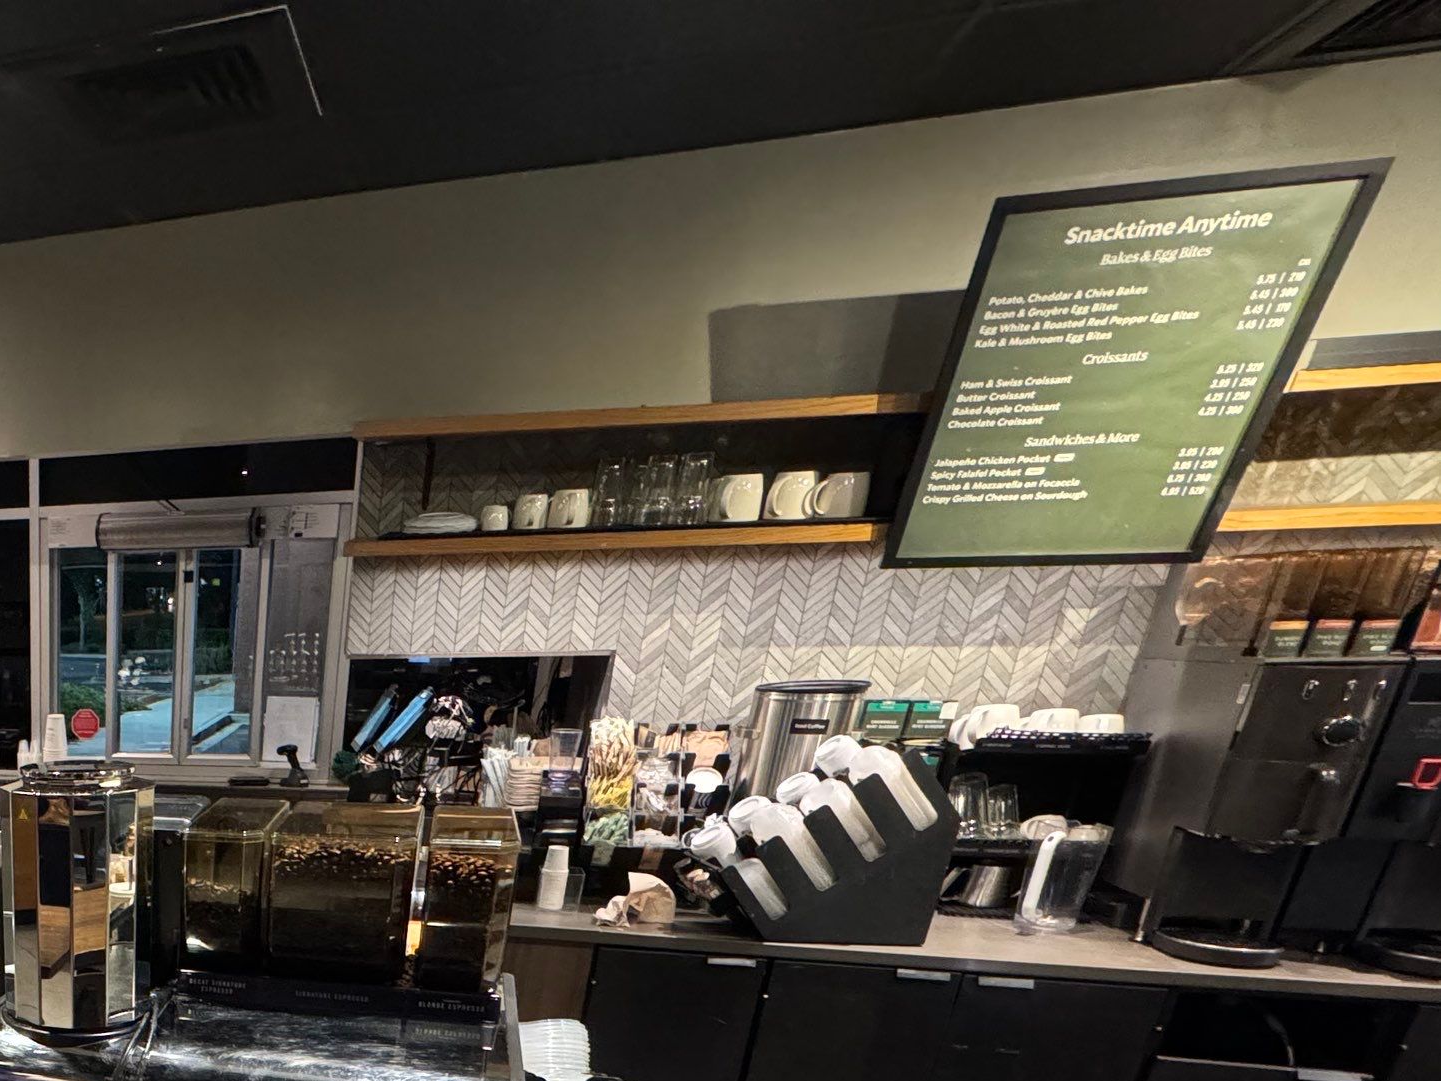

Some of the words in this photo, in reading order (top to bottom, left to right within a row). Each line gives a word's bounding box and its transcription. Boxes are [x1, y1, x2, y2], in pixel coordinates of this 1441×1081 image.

[1063, 218, 1176, 245] Snacktime
[1175, 210, 1272, 235] Anytime
[1099, 251, 1139, 265] Bakes
[1139, 250, 1151, 263] &
[1151, 248, 1178, 263] Egg
[1177, 245, 1212, 259] Bites
[988, 295, 1025, 306] Potato,
[1026, 290, 1073, 303] Cheddar
[1073, 289, 1083, 299] &
[1084, 287, 1115, 298] Chive
[1115, 285, 1148, 296] Bakes
[983, 310, 1015, 320] Bacon
[1016, 308, 1025, 318] &
[1070, 303, 1090, 315] Egg
[1090, 302, 1118, 312] Bites
[978, 324, 998, 336] Egg
[999, 323, 1030, 332] White
[1031, 321, 1040, 330] &
[1041, 318, 1086, 329] Roasted
[1085, 315, 1109, 326] Red
[1108, 315, 1149, 326] Pepper
[1149, 312, 1170, 323] Egg
[1170, 310, 1199, 320] Bites
[973, 337, 997, 348] Kale
[997, 337, 1006, 347] &
[1007, 335, 1064, 346] Mushroom
[1064, 333, 1085, 344] Egg
[1085, 330, 1112, 341] Bites
[1081, 350, 1148, 365] Croissants
[959, 380, 984, 389] Ham
[984, 378, 994, 388] &
[994, 377, 1023, 387] Swiss
[1024, 375, 1073, 386] Croissant
[955, 393, 988, 402] Butter
[988, 390, 1036, 401] Croissant
[951, 405, 982, 416] Baked
[982, 404, 1012, 415] Apple
[1013, 401, 1061, 412] Croissant
[947, 418, 996, 429] Chocolate
[996, 415, 1044, 427] Croissant
[1023, 433, 1095, 447] Sandwiches
[1094, 433, 1106, 444] &
[1105, 432, 1140, 443] More
[977, 455, 1016, 465] Chicken
[1016, 454, 1051, 463] Pocket
[929, 470, 956, 480] Spicy
[956, 468, 988, 478] Falafel
[988, 467, 1022, 477] Pocket
[926, 483, 961, 491] Tomato
[961, 482, 970, 490] &
[971, 480, 1023, 489] Mozzarella
[1038, 477, 1080, 487] Focaccia
[921, 495, 951, 504] Crispy
[951, 493, 984, 502] Grilled
[984, 493, 1019, 501] Cheese
[1033, 489, 1088, 500] Sourdough
[201, 986, 234, 995] ESPRESSO
[418, 1001, 445, 1010] BLONDE
[447, 1002, 485, 1013] ESPRESSO
